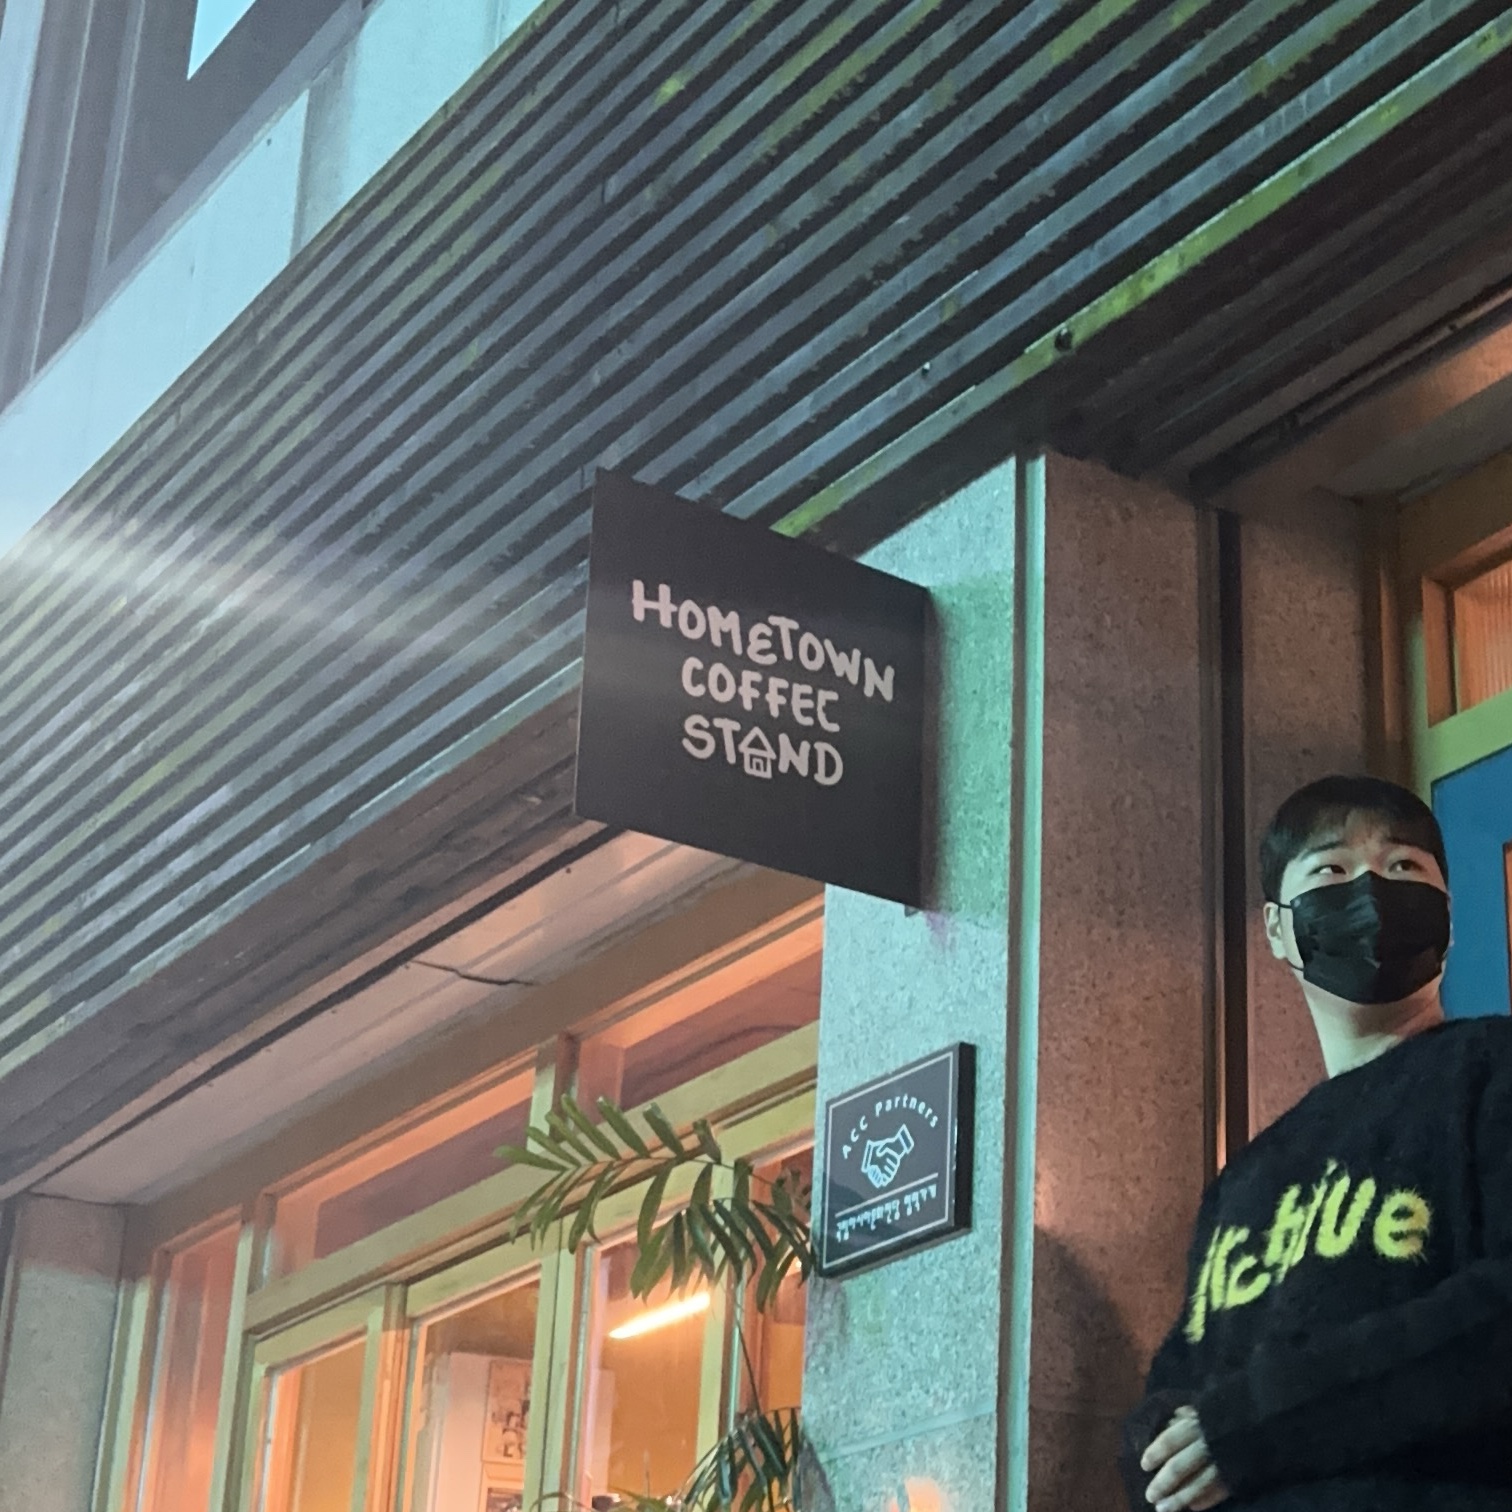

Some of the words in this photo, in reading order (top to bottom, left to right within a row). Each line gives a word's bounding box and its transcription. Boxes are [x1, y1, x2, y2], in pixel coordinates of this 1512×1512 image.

[631, 579, 895, 702] HOMETOWN
[681, 656, 841, 732] COFFEE
[841, 1115, 868, 1160] ACC
[875, 1093, 939, 1128] Partners
